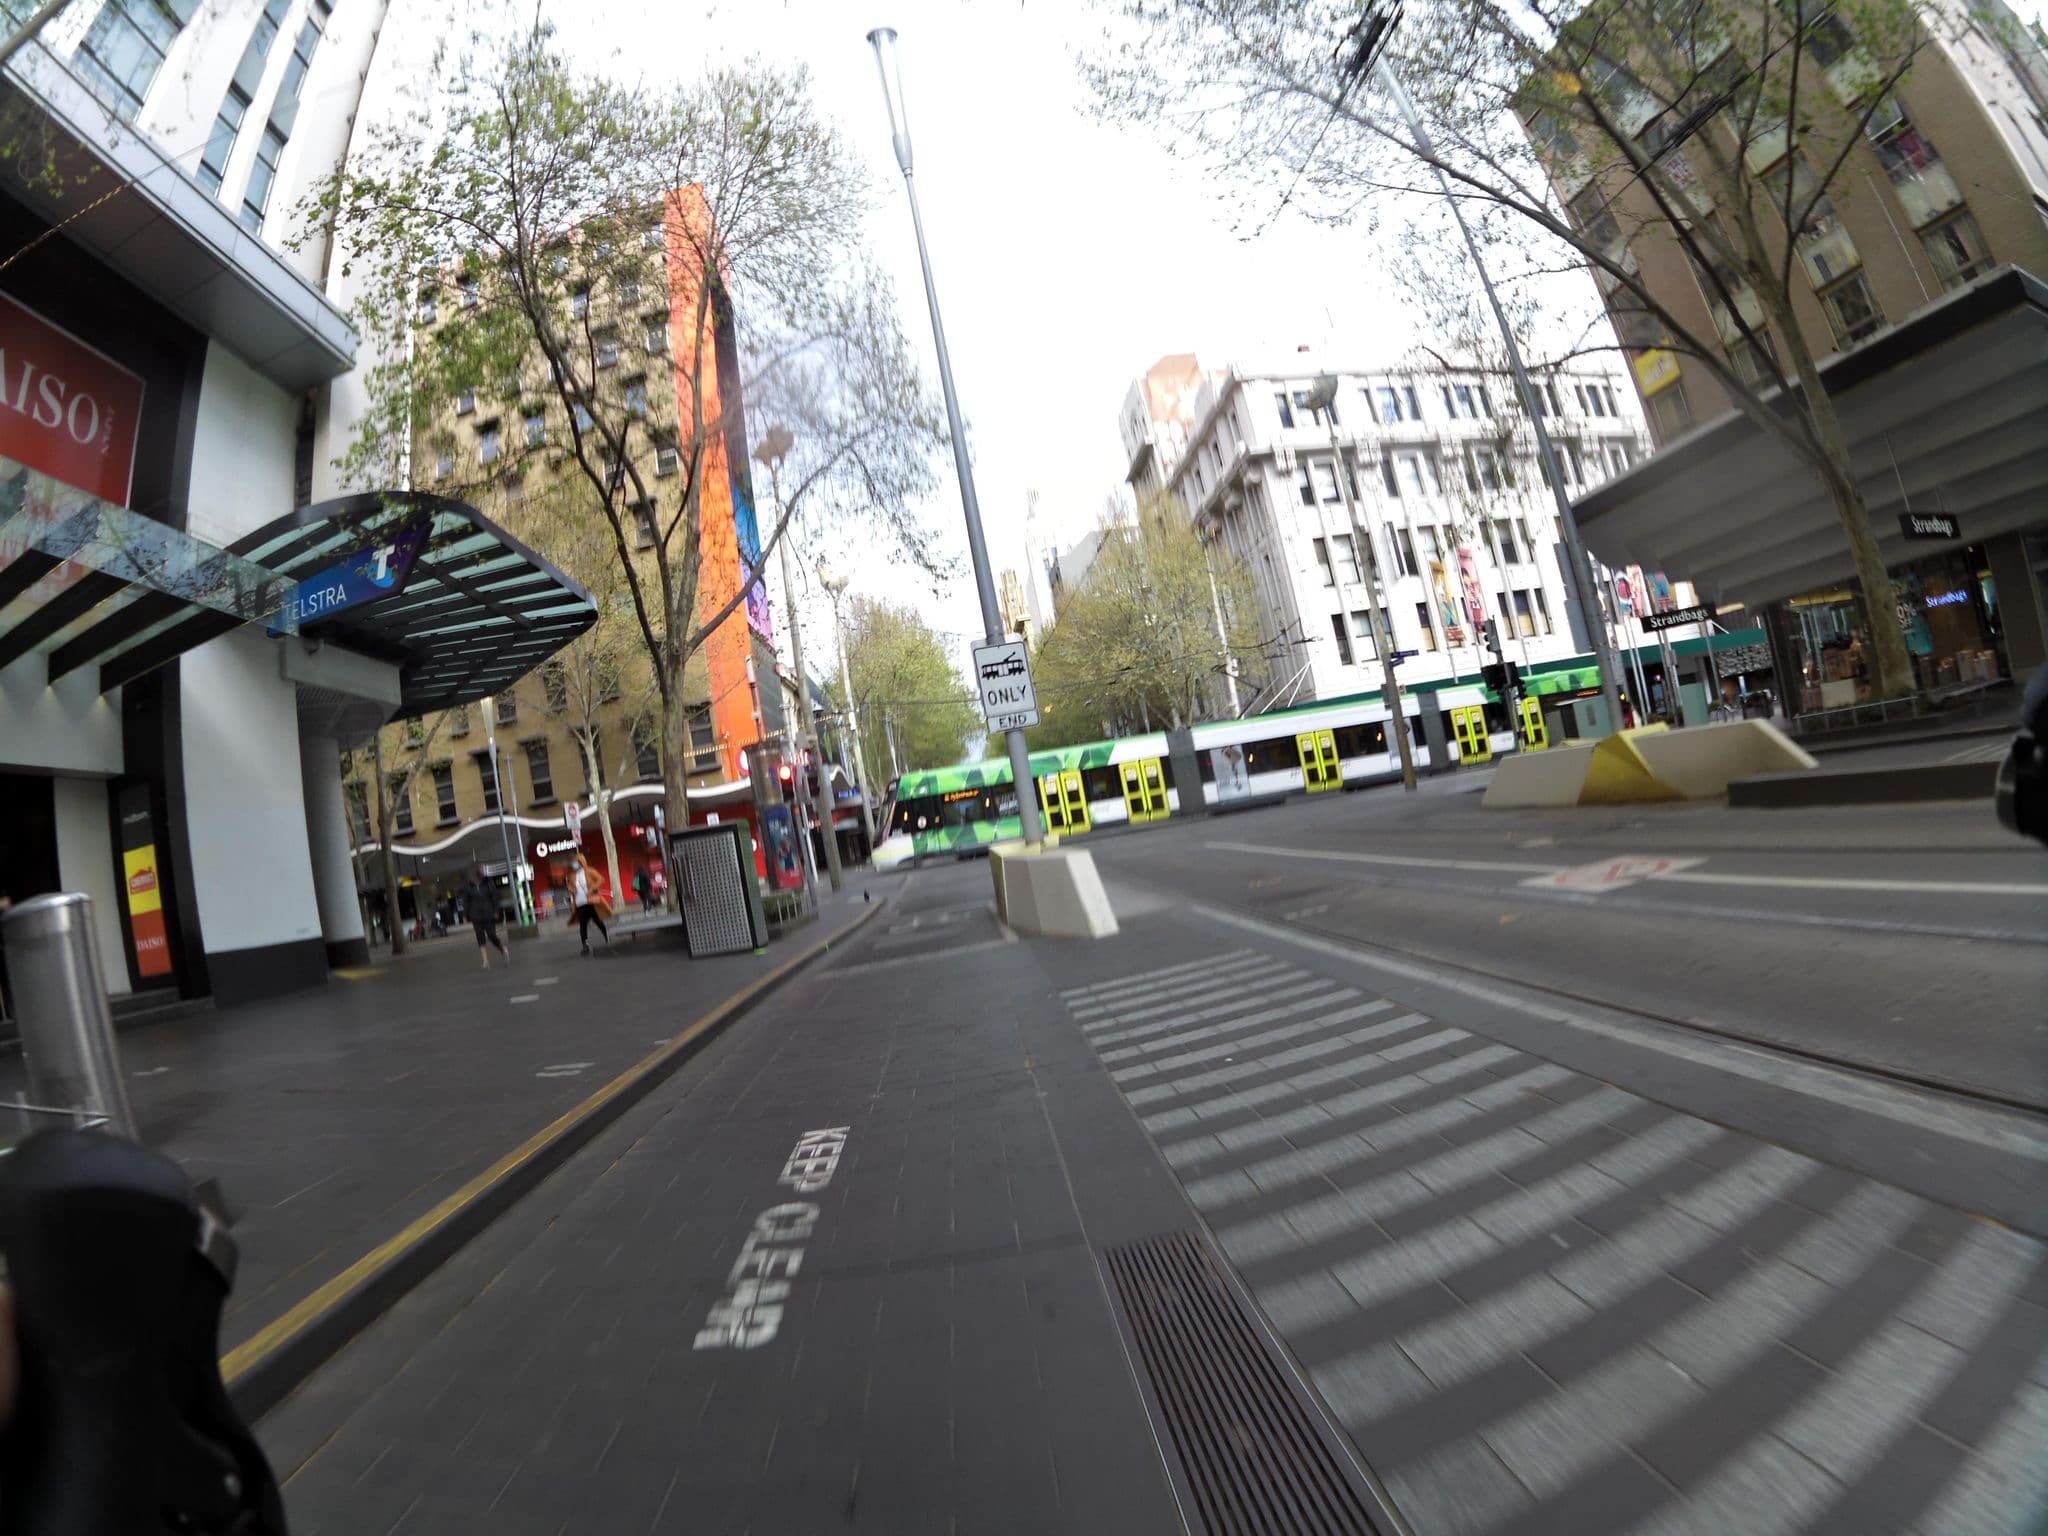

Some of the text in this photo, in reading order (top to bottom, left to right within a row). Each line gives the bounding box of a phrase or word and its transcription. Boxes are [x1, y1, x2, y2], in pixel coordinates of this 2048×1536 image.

[285, 584, 347, 620] TELSTRA
[1649, 609, 1709, 629] Strandbags
[988, 685, 1026, 706] ONLY
[999, 714, 1027, 728] END
[777, 1126, 850, 1192] KEEP
